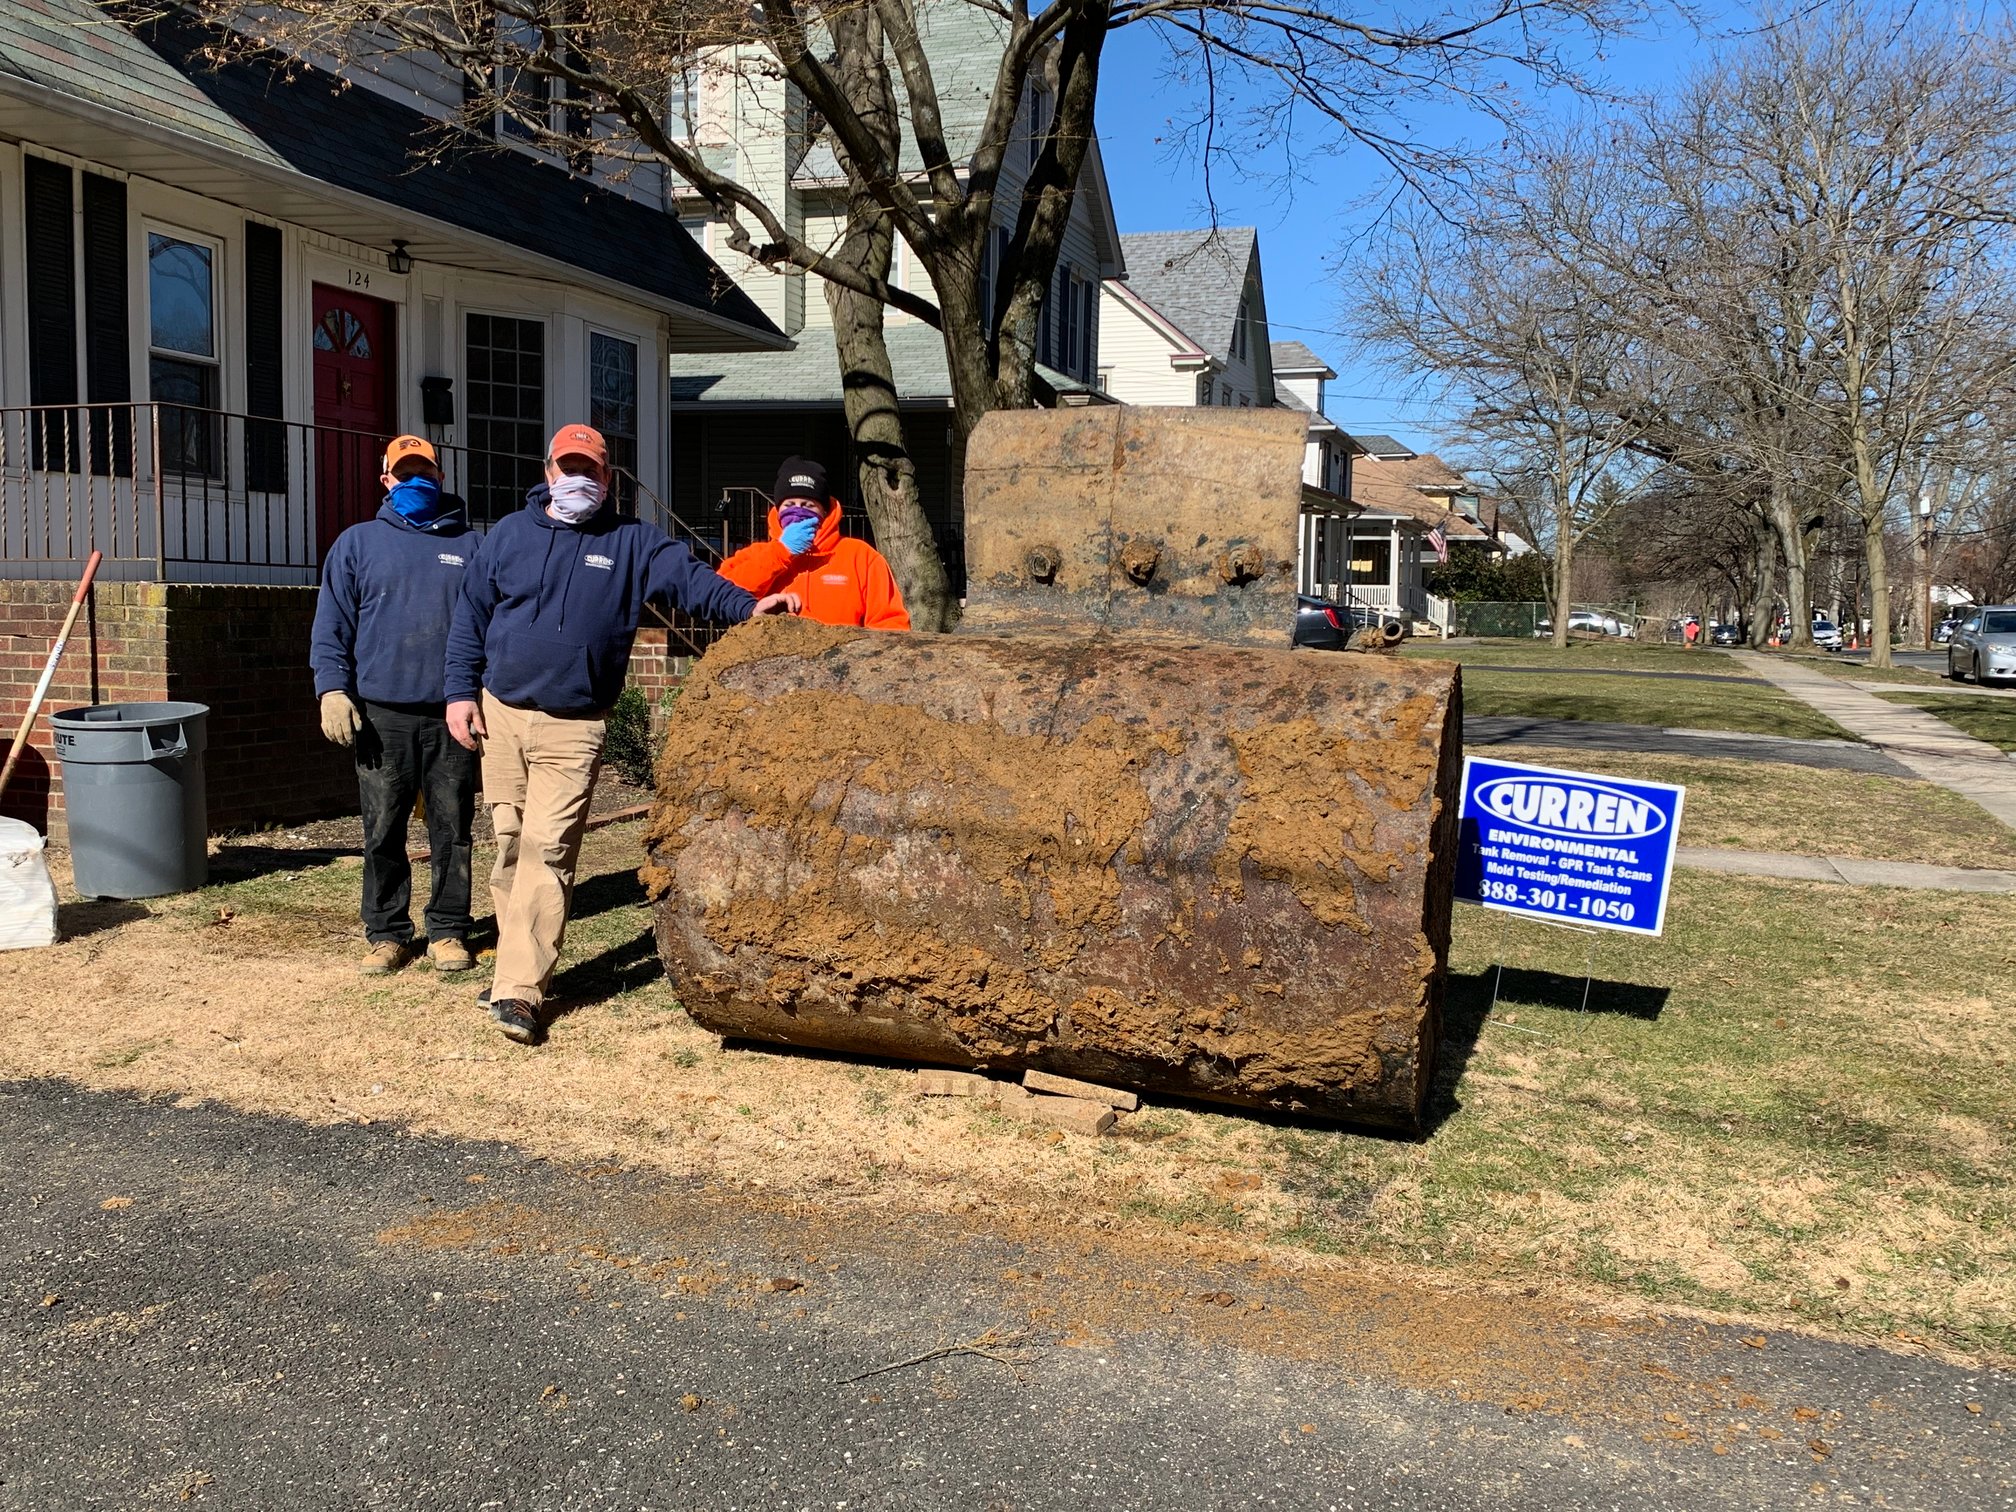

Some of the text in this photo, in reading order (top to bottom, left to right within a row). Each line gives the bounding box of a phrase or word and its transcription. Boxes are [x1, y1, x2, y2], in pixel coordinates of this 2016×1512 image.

[348, 269, 370, 289] 124
[1490, 783, 1649, 834] CURREN
[1473, 843, 1499, 858] Tank
[1501, 848, 1550, 866] Removal
[1558, 857, 1583, 872] GPR
[1586, 861, 1614, 876] Tank
[1616, 866, 1653, 882] Scans
[1488, 829, 1639, 864] ENVIRONMENTAL
[1486, 861, 1632, 895] Mold Testing/Remediation
[1478, 879, 1635, 921] 888-301-1050
